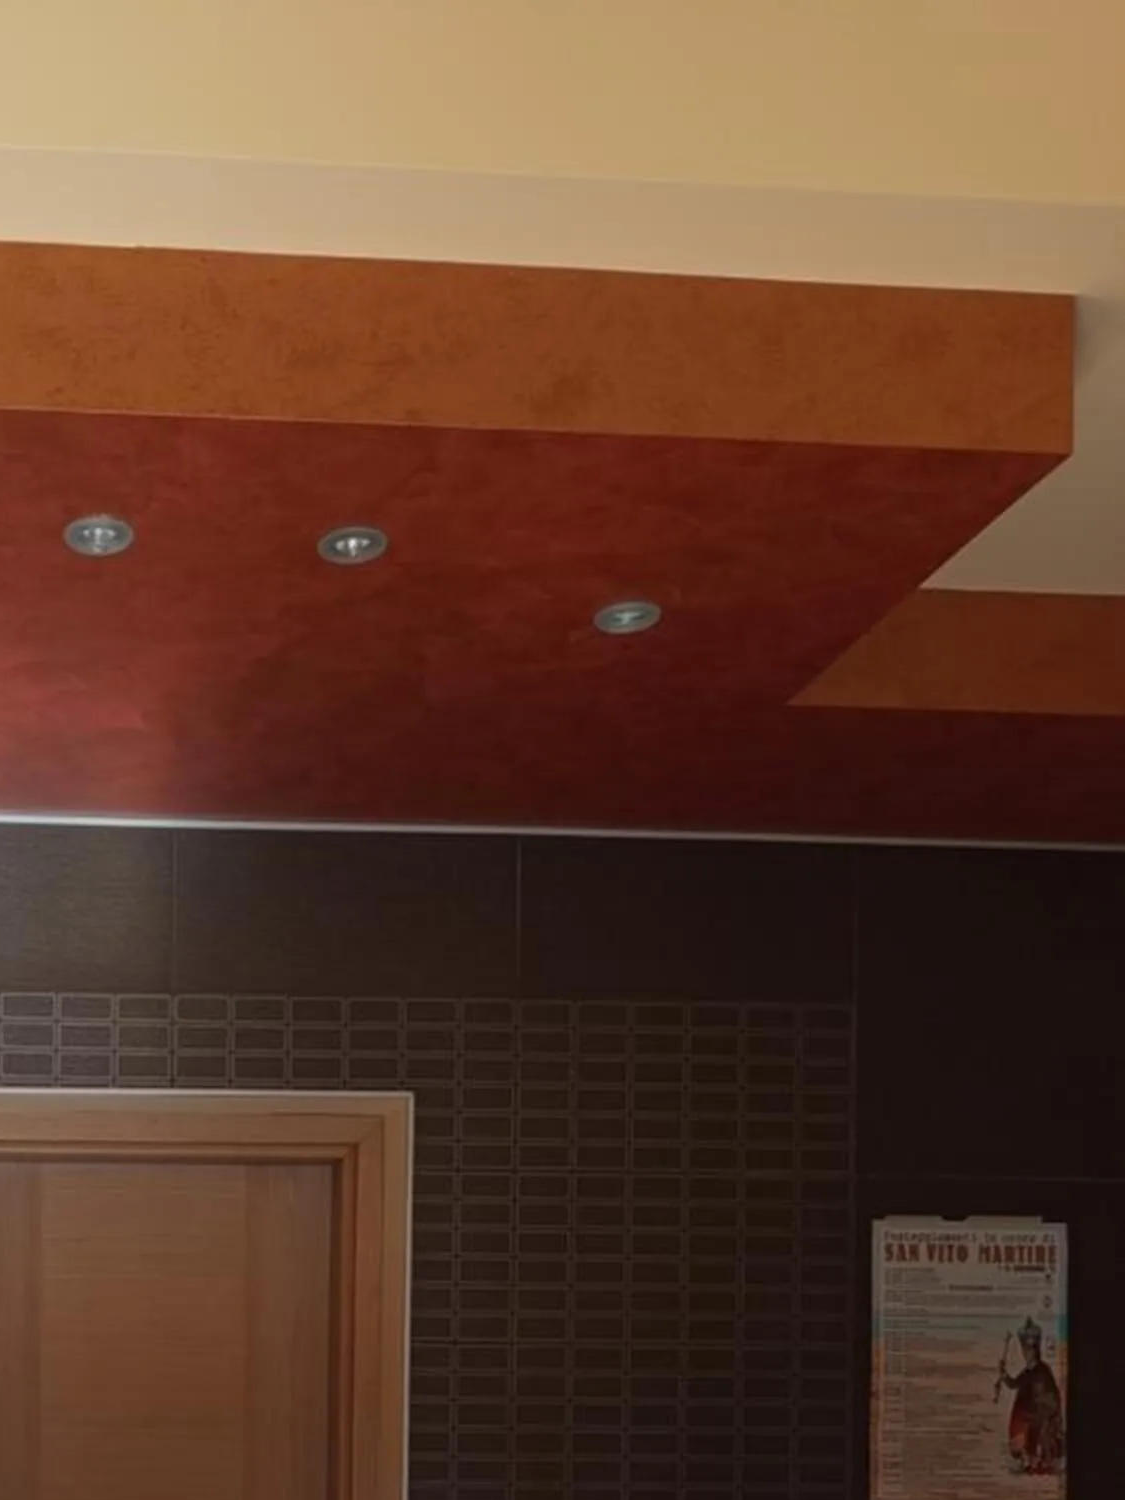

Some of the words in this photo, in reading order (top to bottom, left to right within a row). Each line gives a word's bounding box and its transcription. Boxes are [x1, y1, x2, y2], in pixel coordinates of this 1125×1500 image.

[884, 1243, 920, 1262] SAN
[926, 1243, 969, 1263] VITO
[978, 1244, 1057, 1264] MARTIRE
